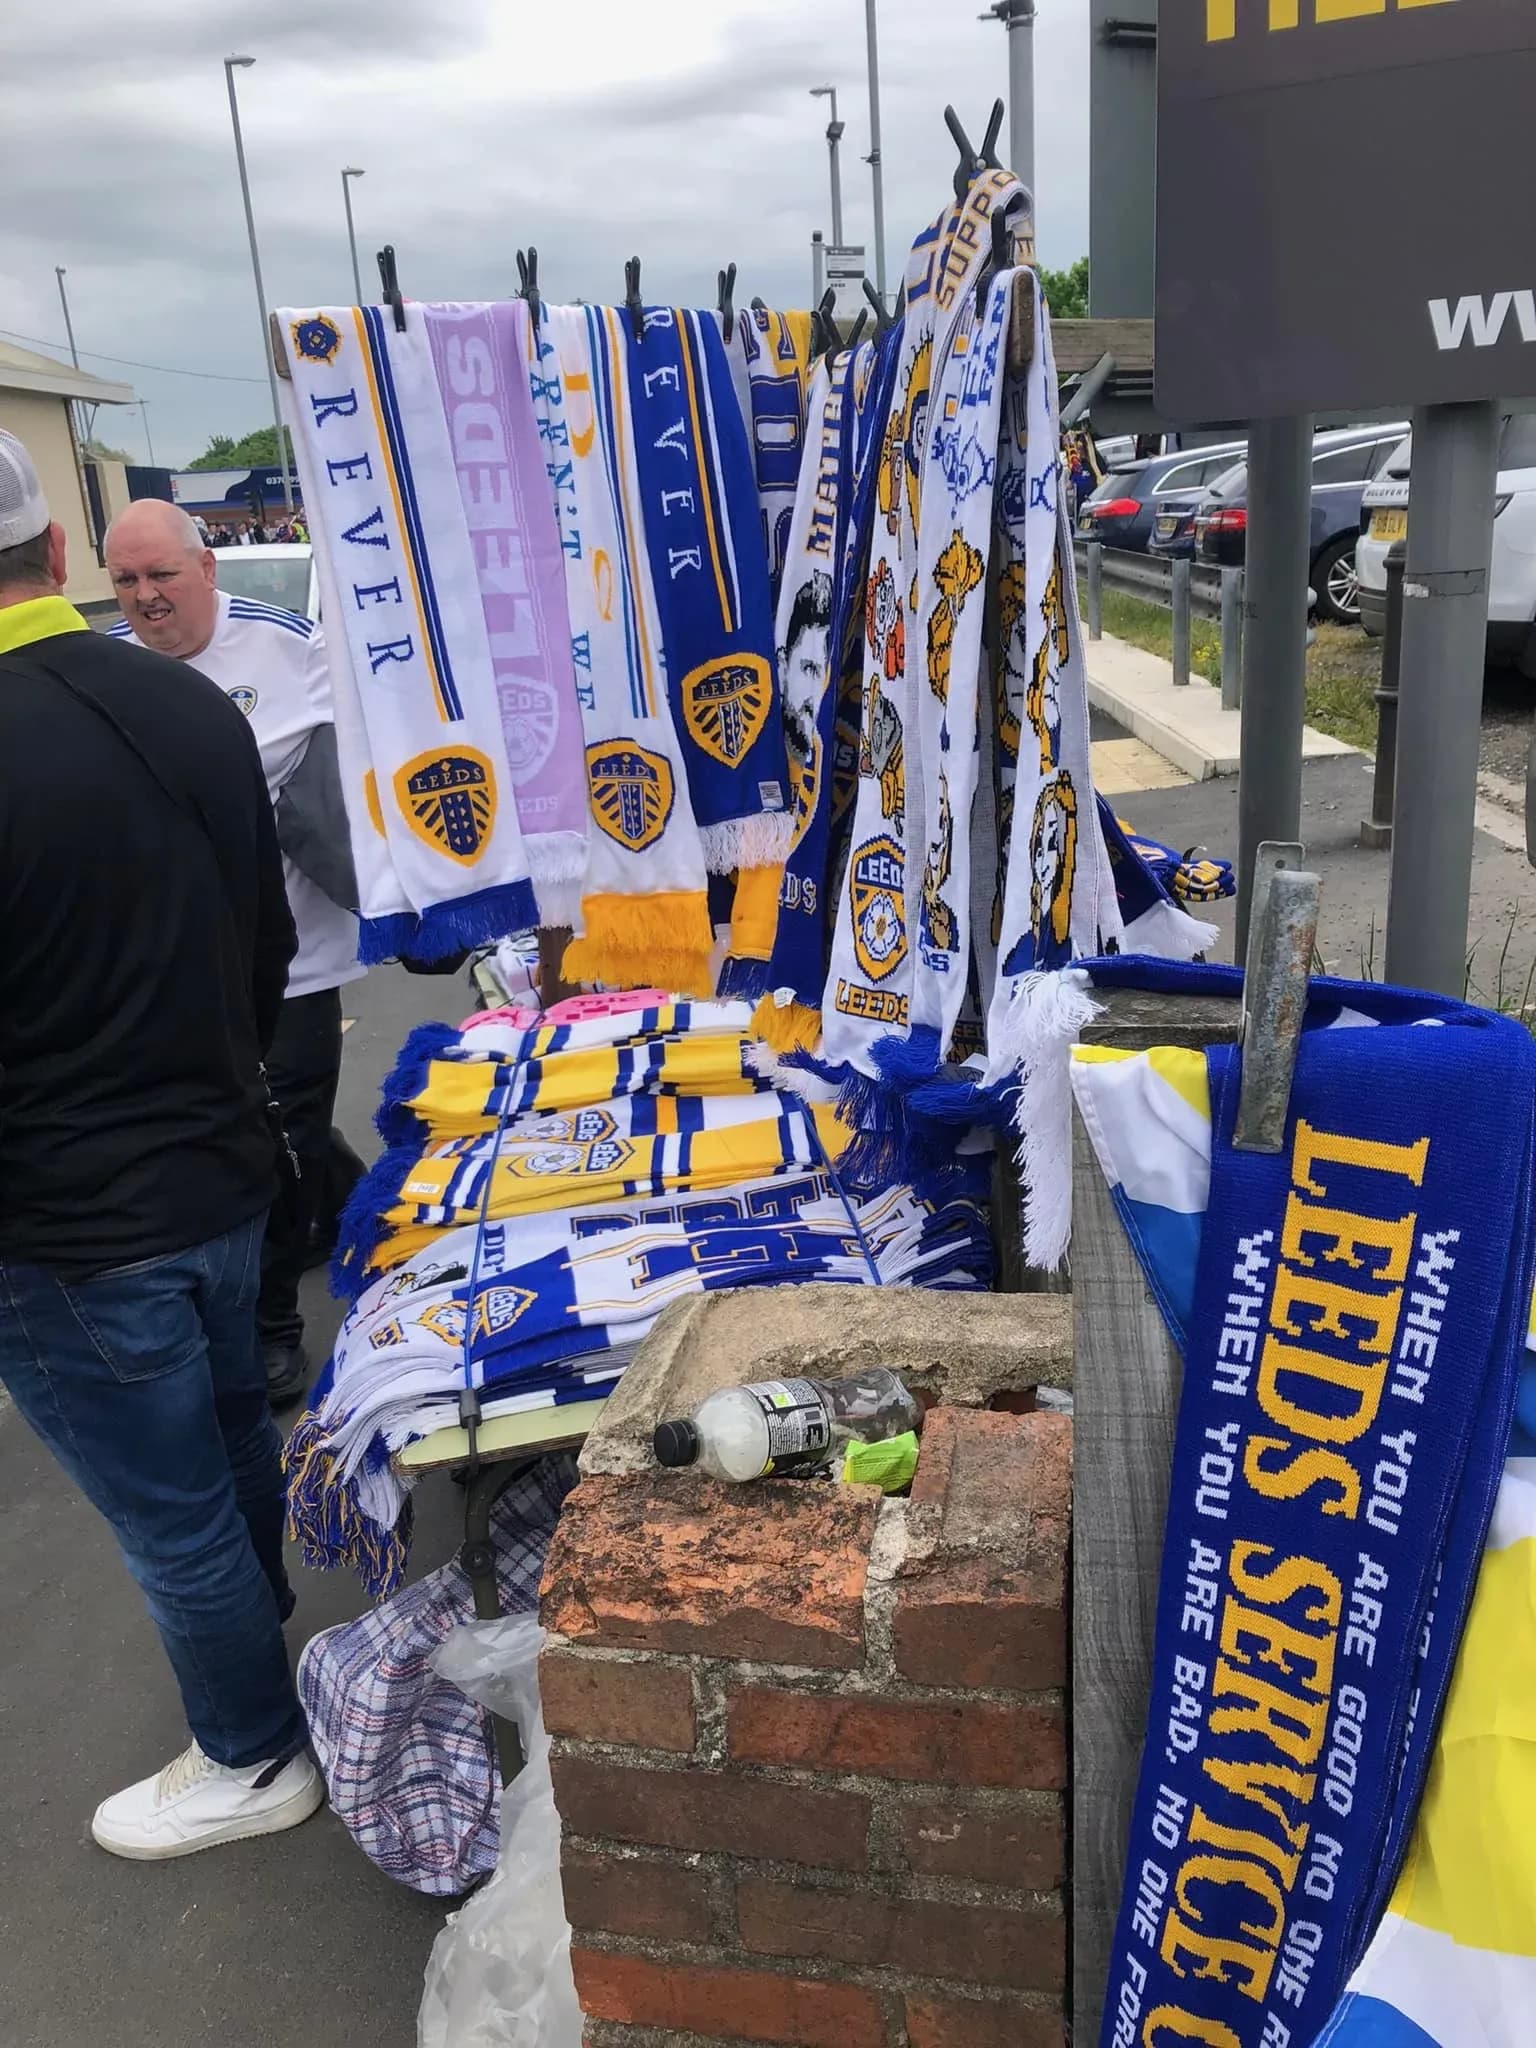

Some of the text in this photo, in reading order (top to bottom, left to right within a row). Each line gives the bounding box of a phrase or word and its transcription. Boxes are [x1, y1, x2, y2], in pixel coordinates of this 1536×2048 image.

[502, 689, 548, 711] EDS
[701, 671, 754, 698] LEEDS
[416, 766, 483, 791] LEEDS
[857, 855, 904, 888] LEED
[1211, 1229, 1275, 1398] WHEN
[1242, 1118, 1430, 1521] LEEDS
[1391, 1228, 1462, 1404] WHEN
[1195, 1423, 1241, 1520] YOU
[1366, 1429, 1418, 1536] YOU
[1181, 1538, 1224, 1641] ARE
[1343, 1551, 1389, 1667] ARE
[1159, 1539, 1343, 2003] SERVICE
[1322, 1683, 1368, 1818] GOOD
